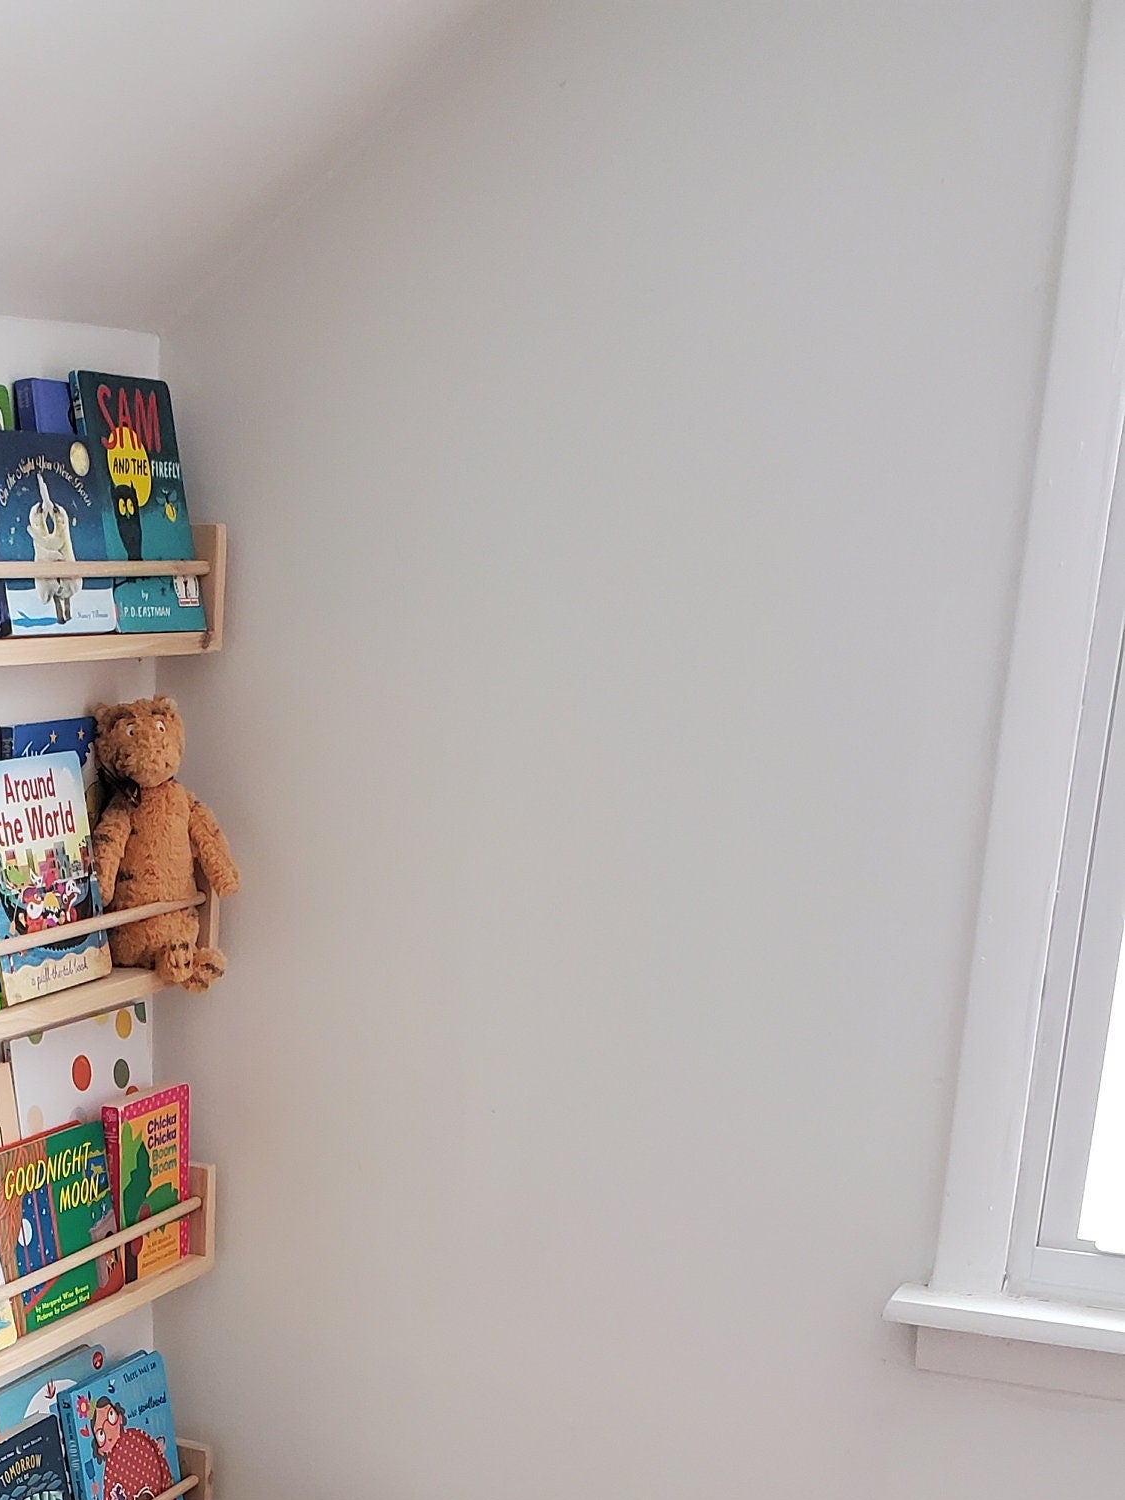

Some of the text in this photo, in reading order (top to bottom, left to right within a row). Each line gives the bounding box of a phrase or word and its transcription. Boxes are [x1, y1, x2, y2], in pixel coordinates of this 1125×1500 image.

[97, 384, 162, 453] SAM
[35, 454, 52, 472] You
[113, 457, 180, 480] AND THE FIREFLY
[141, 589, 149, 601] by
[138, 606, 171, 618] EASTMAN
[3, 767, 56, 804] Around
[24, 800, 76, 841] World
[147, 1112, 177, 1135] Chicka
[147, 1128, 177, 1150] Chicka
[152, 1144, 177, 1162] Boom
[4, 1141, 92, 1200] GOODNIGHT
[152, 1159, 177, 1177] Boom
[59, 1173, 99, 1214] MOON
[0, 1453, 42, 1487] TOMORROW
